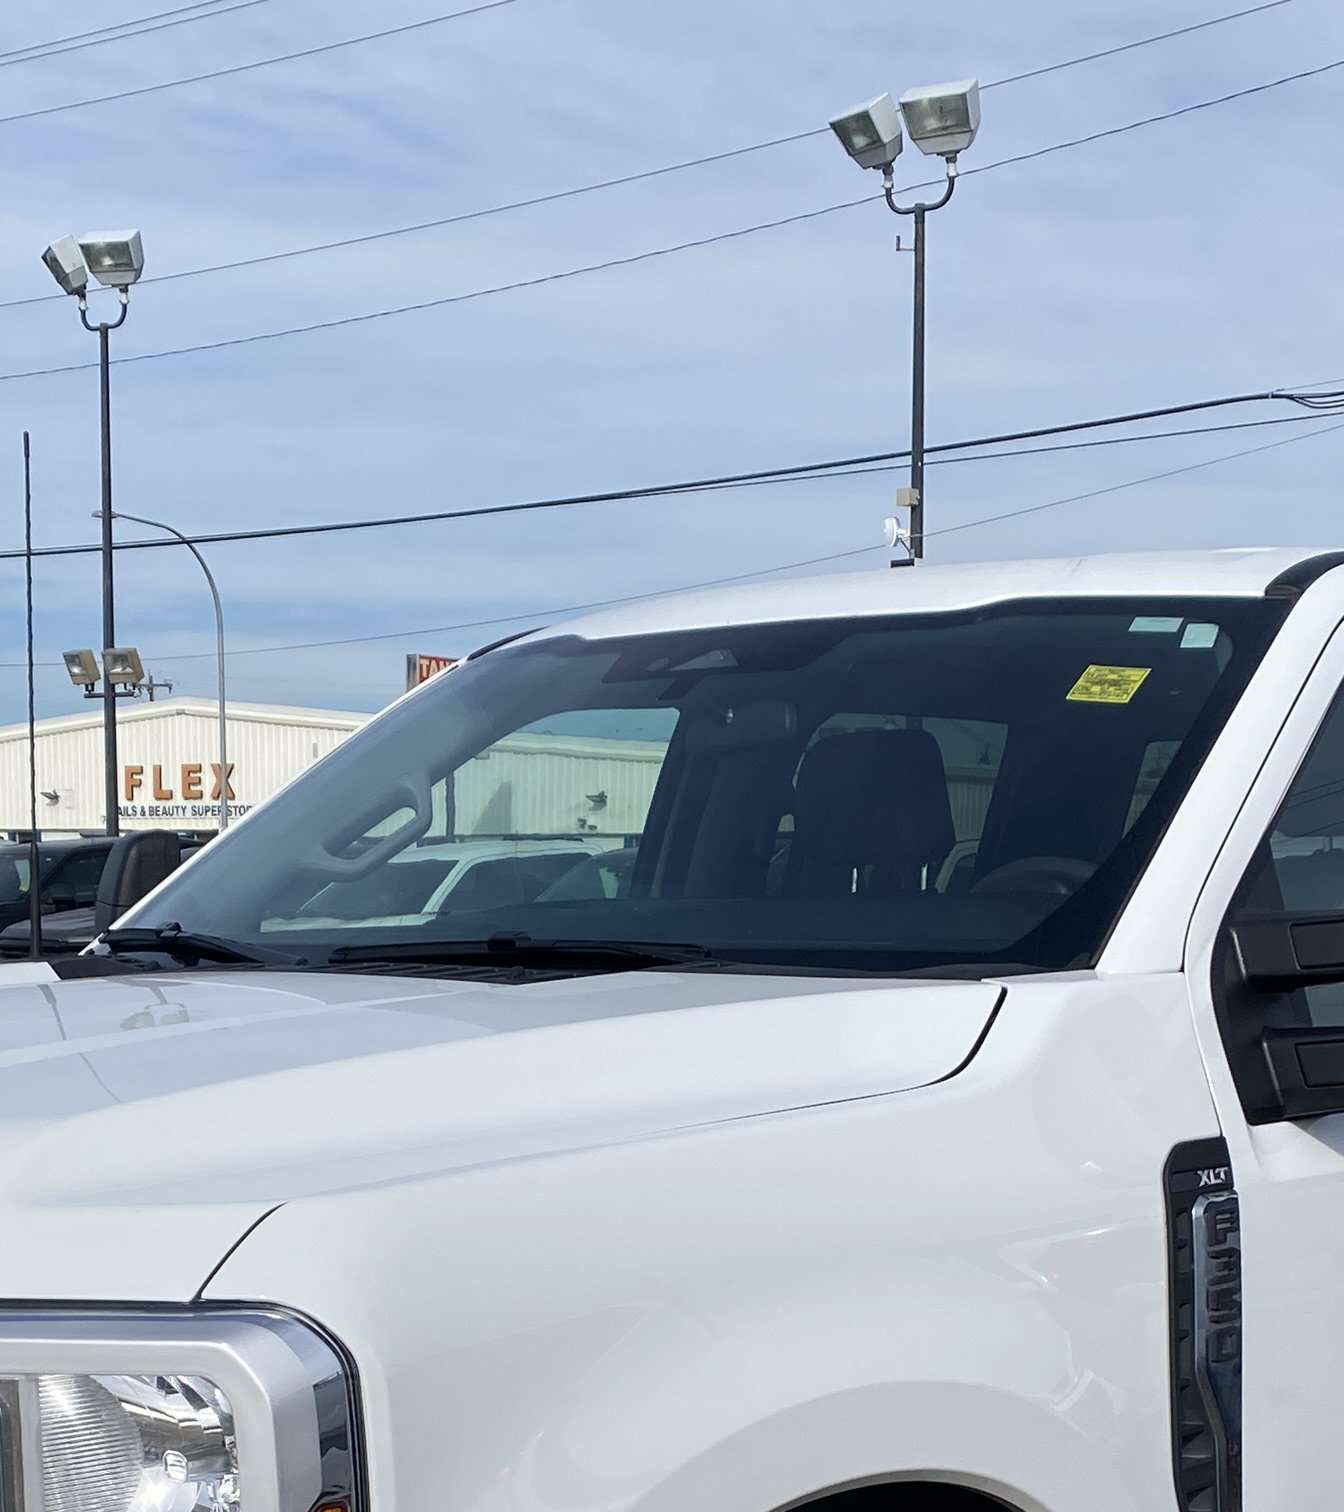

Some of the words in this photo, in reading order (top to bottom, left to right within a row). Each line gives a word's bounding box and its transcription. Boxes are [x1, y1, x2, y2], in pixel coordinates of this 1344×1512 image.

[124, 764, 236, 800] FLEX
[117, 805, 137, 817] AILS
[149, 805, 186, 817] BEAUTY
[1197, 1167, 1229, 1187] XLT
